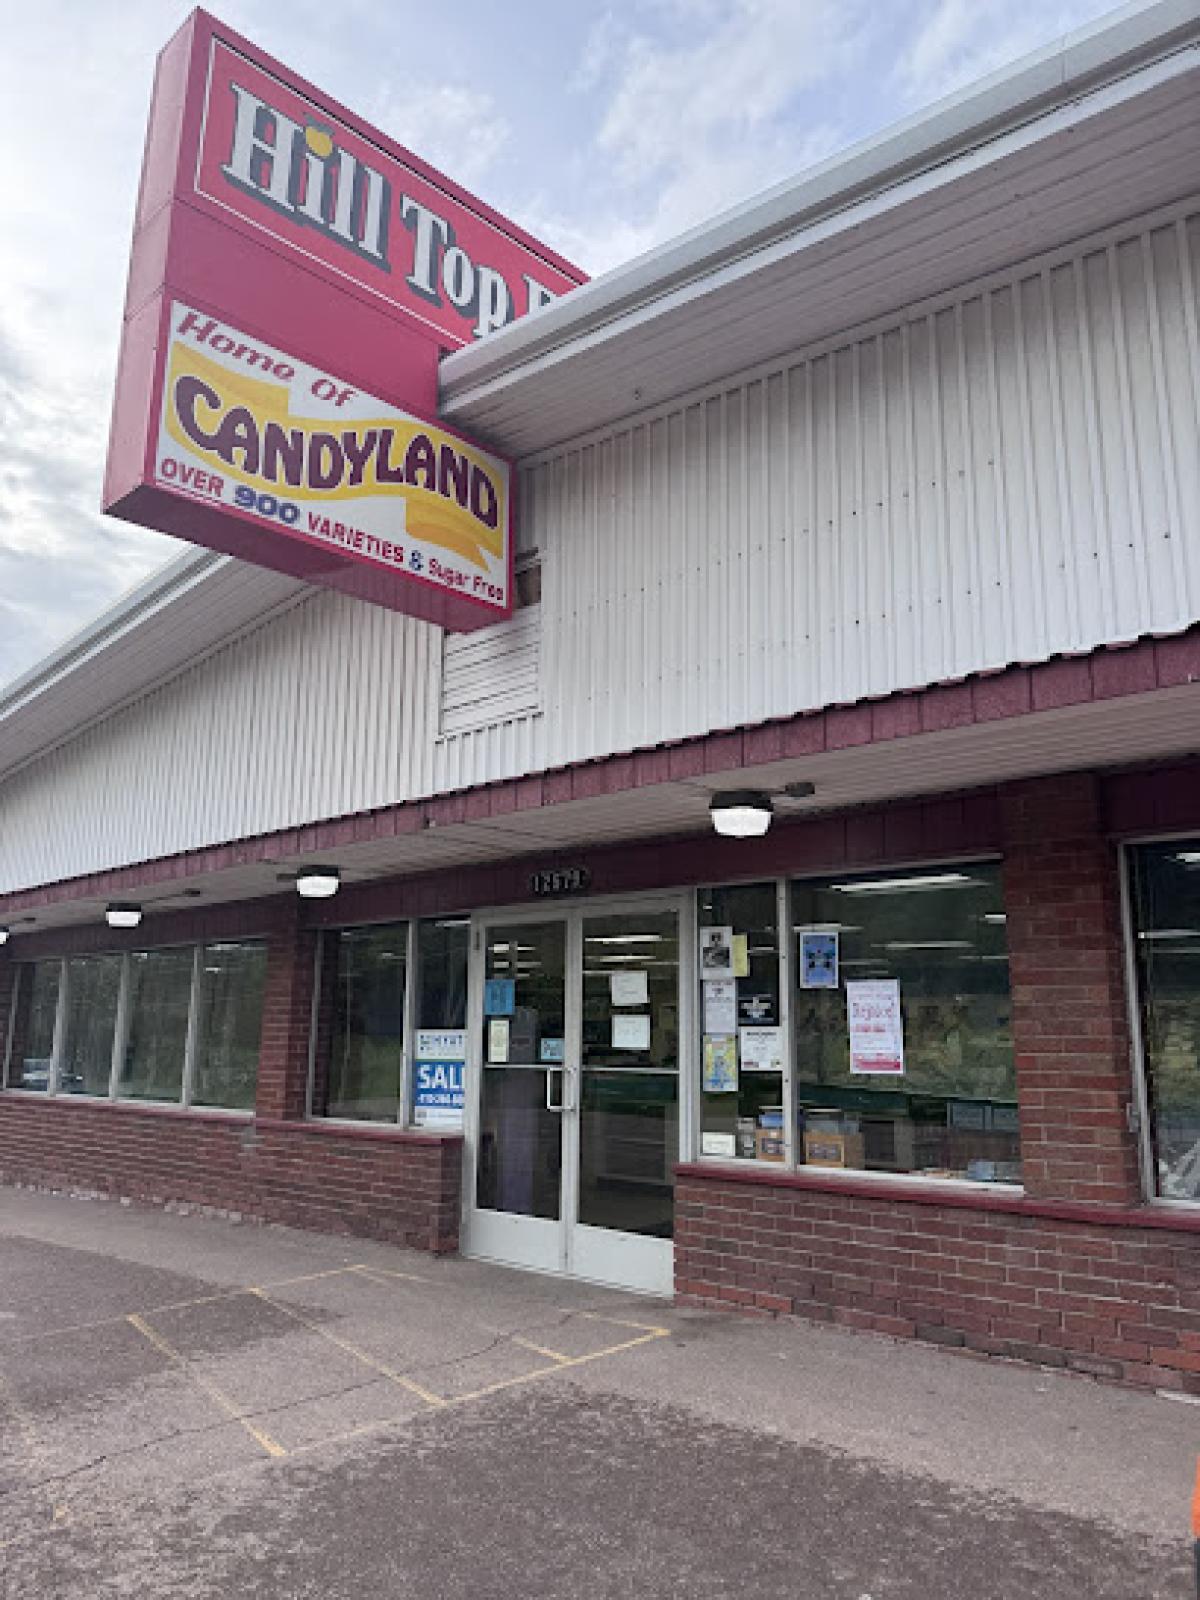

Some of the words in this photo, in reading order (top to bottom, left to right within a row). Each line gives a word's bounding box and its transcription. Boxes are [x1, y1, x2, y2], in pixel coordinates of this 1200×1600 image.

[221, 82, 389, 271] Hill
[401, 194, 513, 337] Top
[177, 312, 296, 382] Home
[175, 375, 498, 530] CANDYLAND
[161, 458, 224, 498] OVER
[234, 484, 300, 525] 900
[308, 511, 404, 563] VARIETIES
[411, 550, 424, 572] &
[428, 558, 471, 589] Sugar
[473, 575, 504, 602] Free
[417, 1064, 464, 1089] SAL
